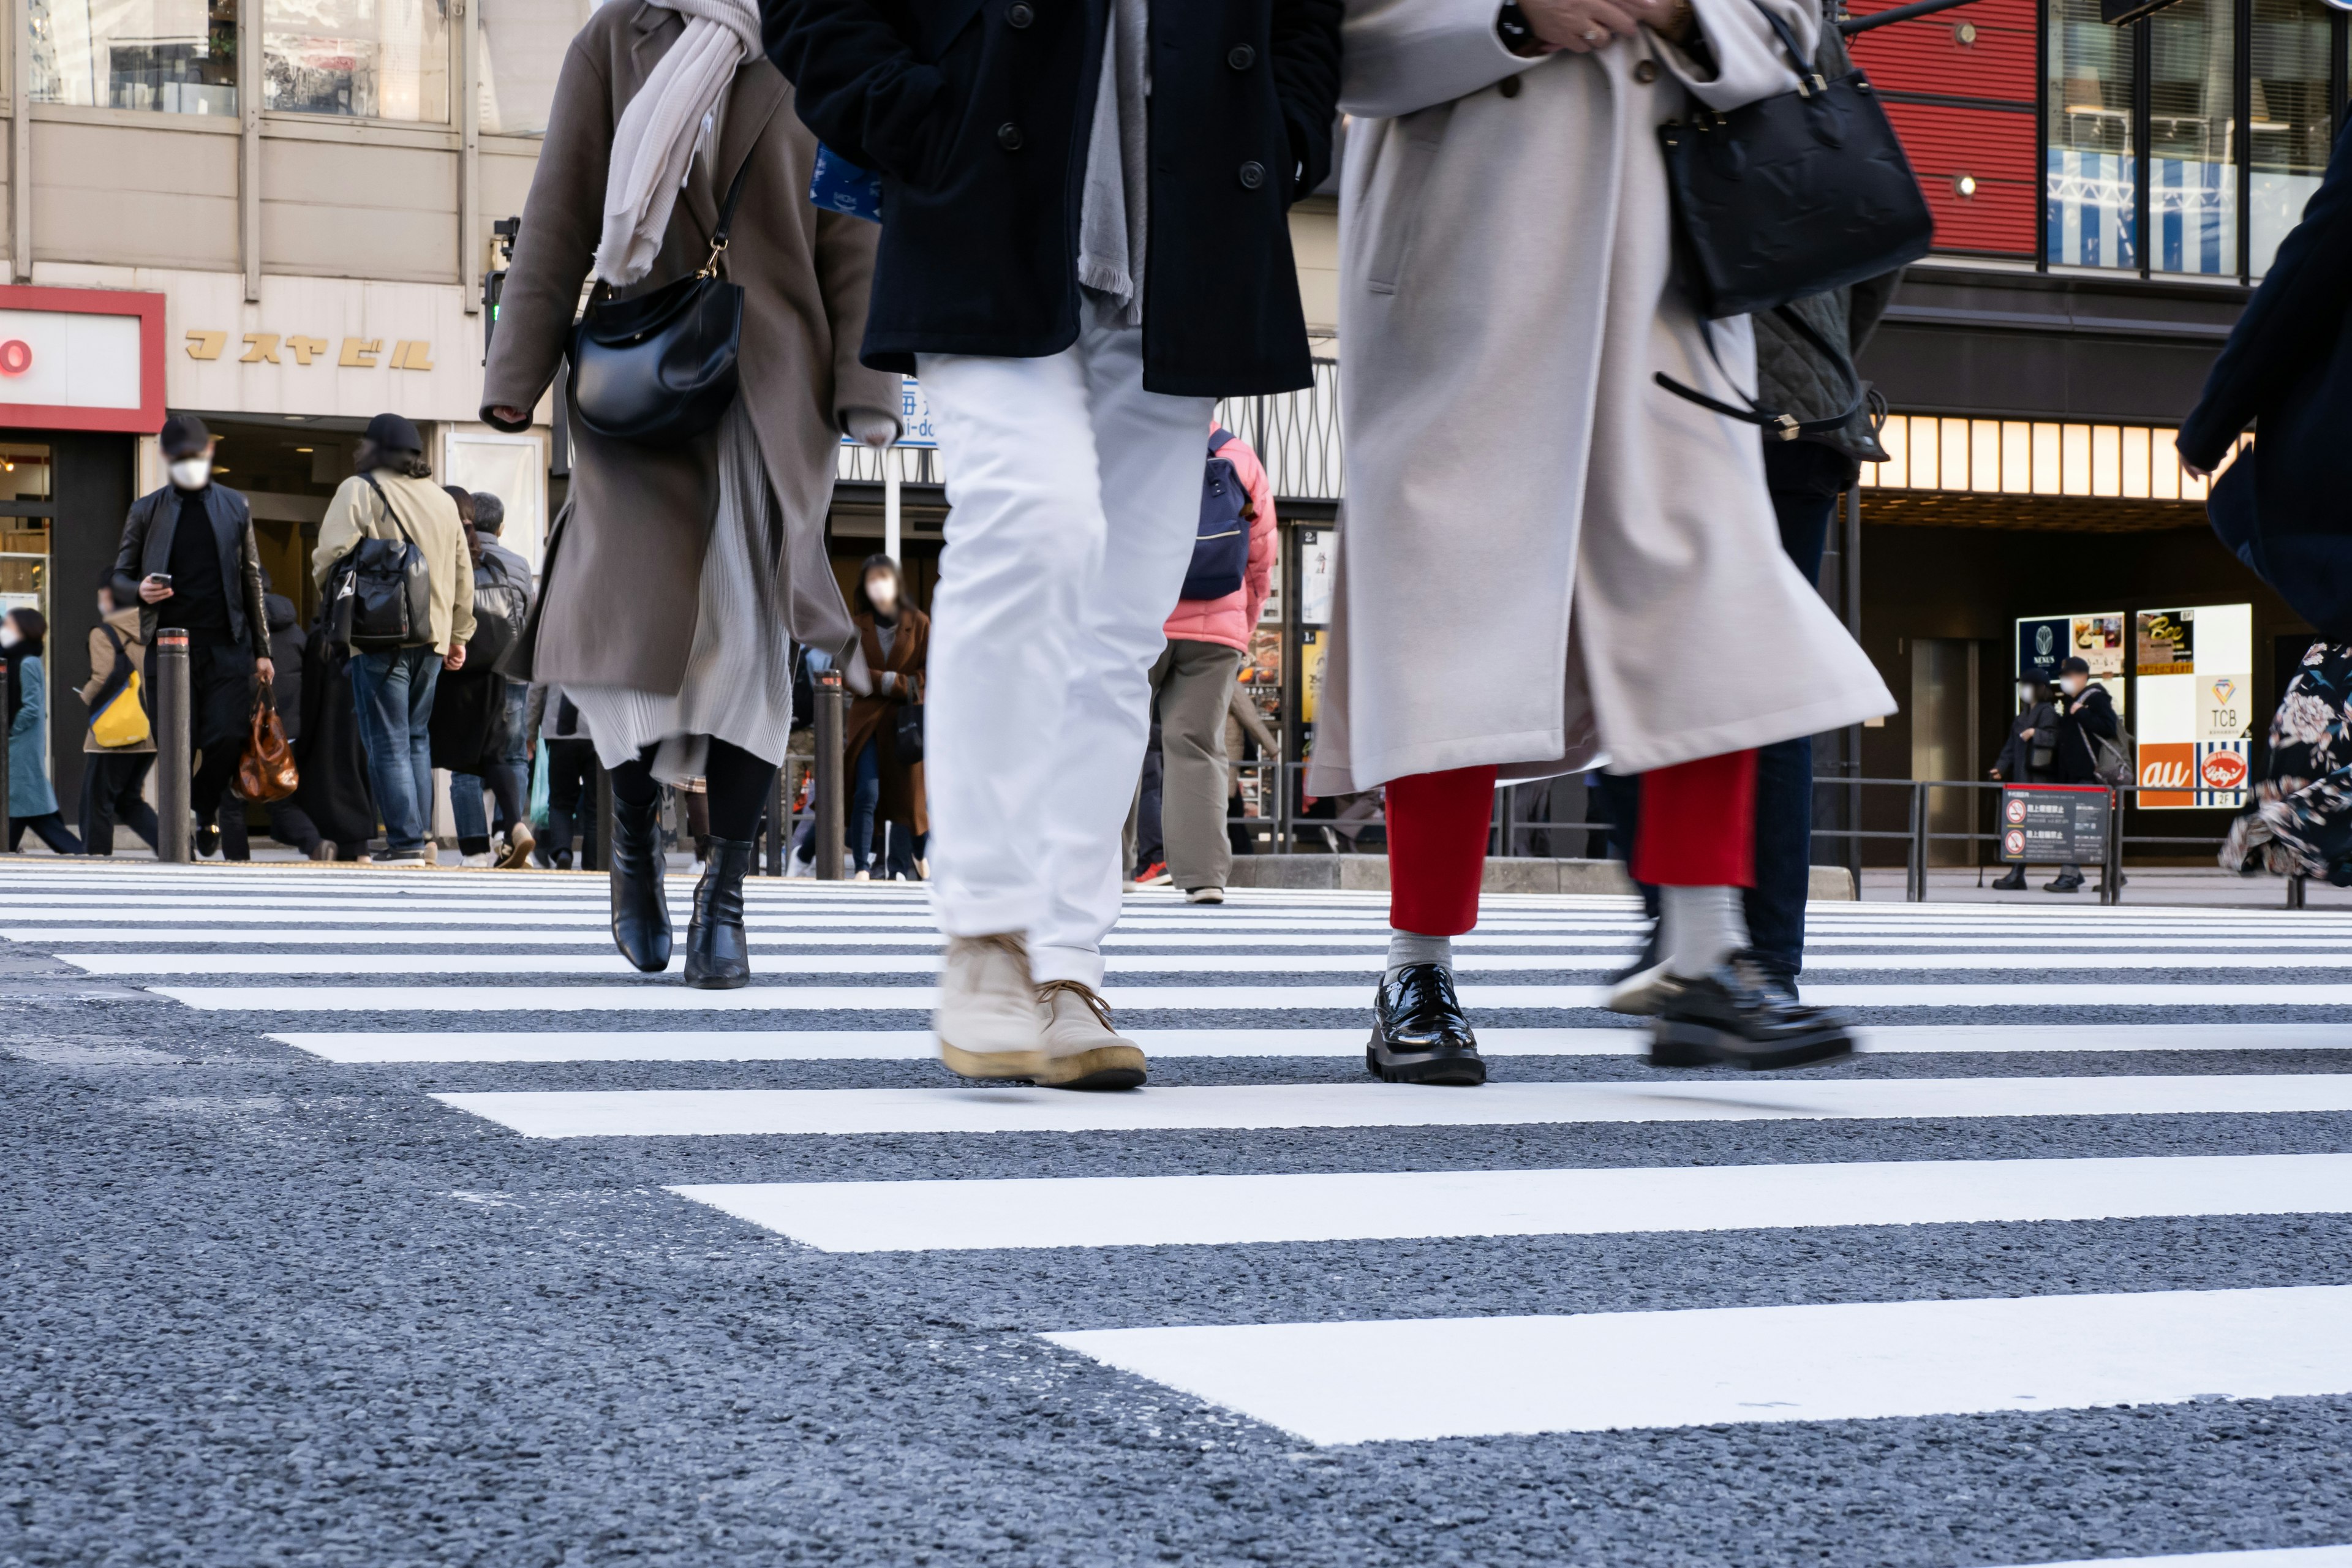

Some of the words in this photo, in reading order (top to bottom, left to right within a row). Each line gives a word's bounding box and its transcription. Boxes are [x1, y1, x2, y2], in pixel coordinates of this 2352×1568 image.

[186, 330, 434, 371] マスヤビル
[2148, 616, 2185, 641] Bee
[2211, 709, 2237, 727] TCB
[2142, 761, 2190, 787] au
[2218, 794, 2230, 804] 2F
